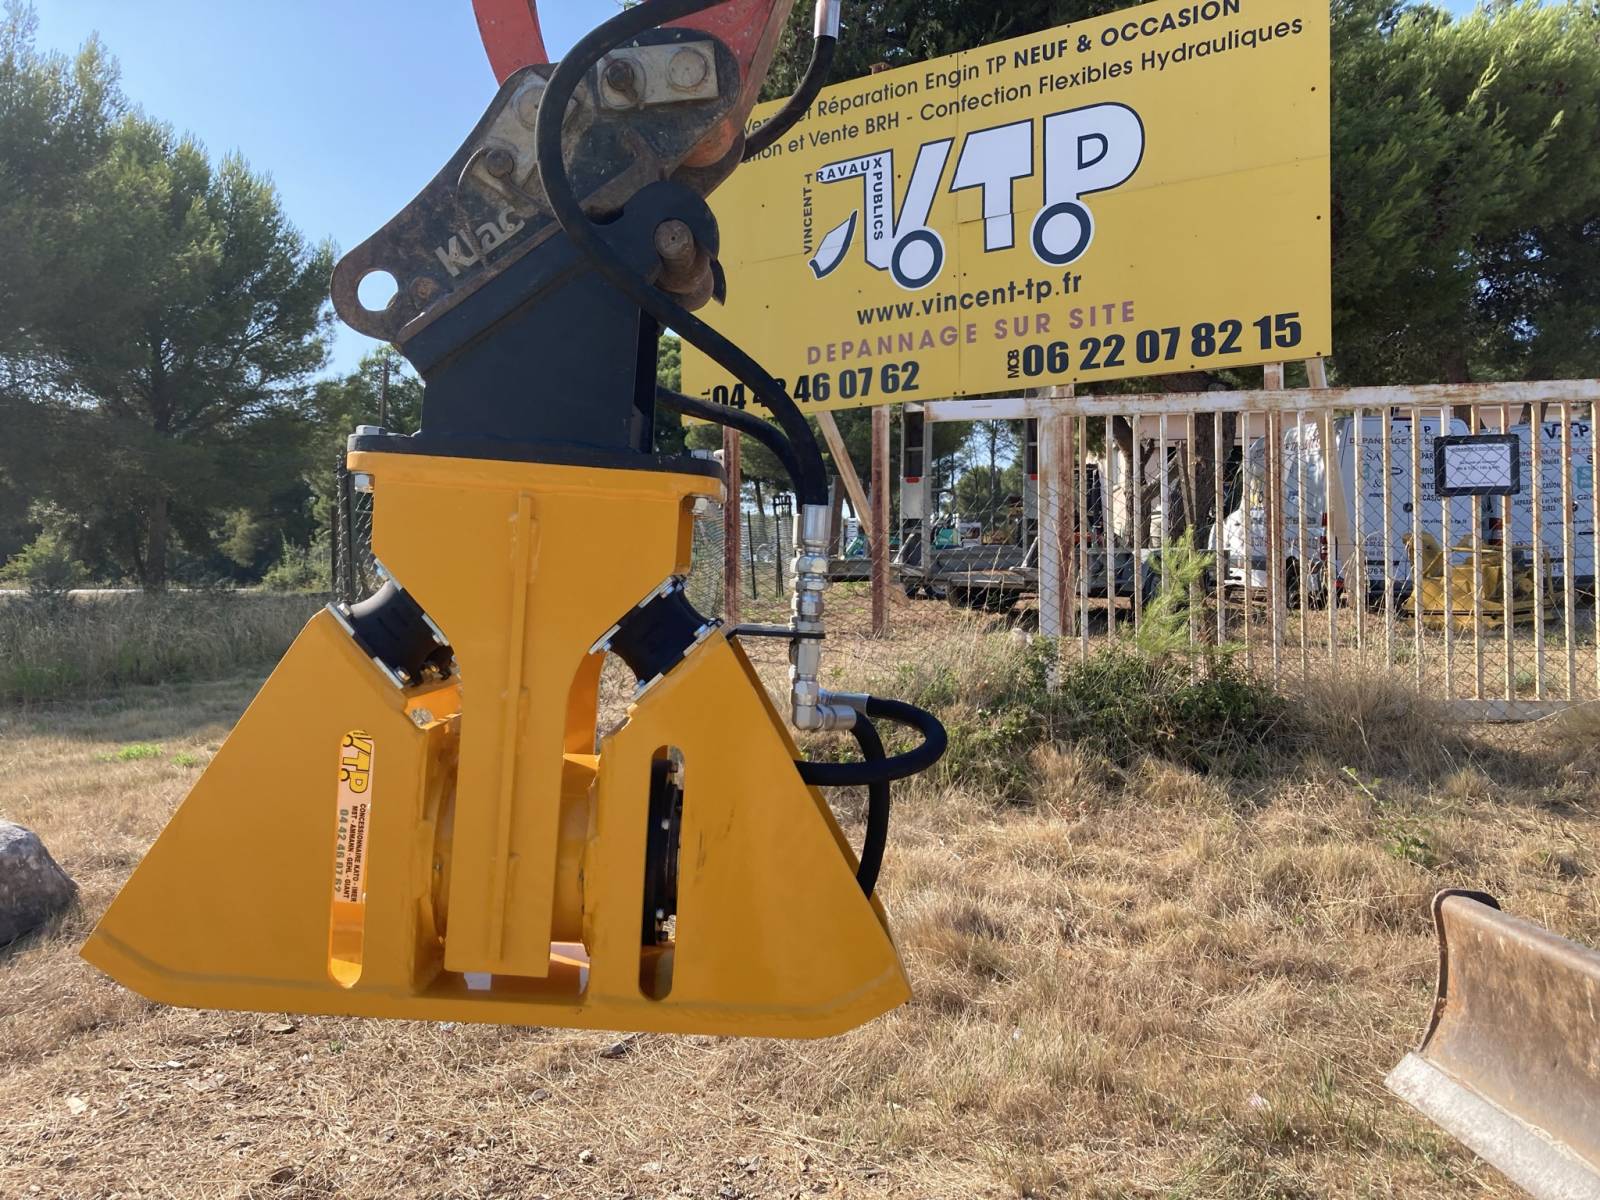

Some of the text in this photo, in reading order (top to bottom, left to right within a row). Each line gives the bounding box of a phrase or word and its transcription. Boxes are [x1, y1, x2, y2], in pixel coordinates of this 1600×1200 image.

[788, 134, 803, 152] et
[809, 123, 859, 147] Vente
[865, 111, 899, 134] BRH
[920, 84, 1031, 120] Confection
[1039, 60, 1133, 95] Flexibles
[1142, 18, 1303, 71] Hydrauliques
[818, 81, 918, 117] Réparation
[925, 64, 979, 90] Engin
[986, 55, 1006, 75] TP
[1014, 39, 1067, 68] NEUF
[1076, 34, 1091, 53] &
[1100, 0, 1240, 46] OCCASION
[434, 206, 525, 277] Klac
[803, 187, 812, 255] VINCENT
[873, 171, 883, 240] PUBLICS
[857, 272, 1081, 325] www.vincent-tp.fr
[807, 301, 1134, 365] DEPANNAGE SUR SITE
[1007, 312, 1301, 378] MOB 06 22 07 82 15
[712, 383, 746, 409] 04
[793, 372, 831, 403] 46
[839, 367, 873, 399] 07
[880, 360, 920, 394] 62
[337, 826, 347, 840] 42
[339, 809, 349, 823] 04
[354, 803, 367, 863] CONCESSIONNAIRE
[335, 862, 344, 875] 07
[336, 844, 345, 858] 46
